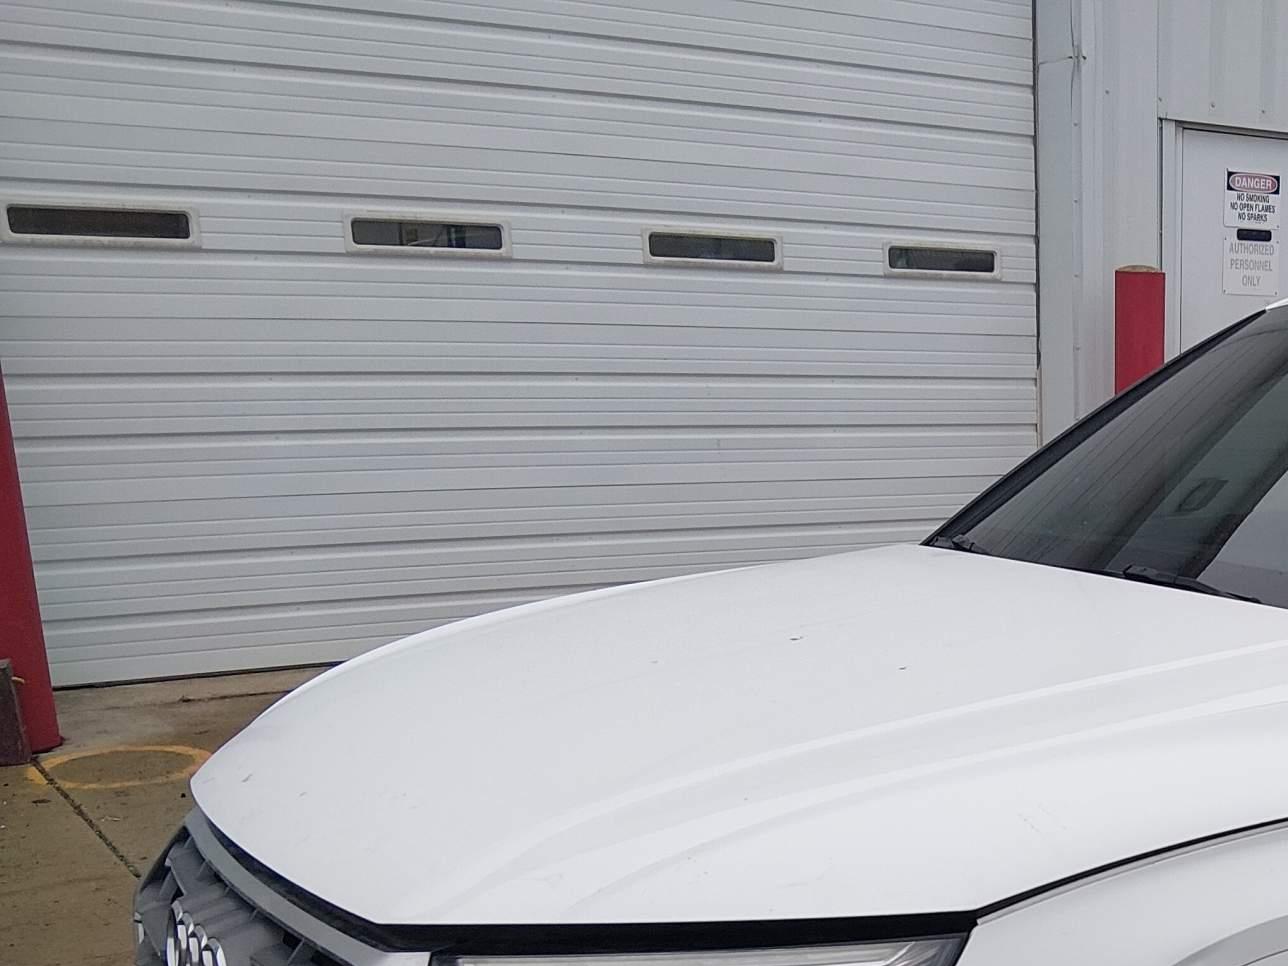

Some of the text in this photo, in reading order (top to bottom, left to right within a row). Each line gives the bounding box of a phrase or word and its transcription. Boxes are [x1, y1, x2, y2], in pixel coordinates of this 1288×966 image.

[1235, 176, 1272, 190] DANGER
[1237, 193, 1270, 203] NO SMOKING
[1230, 202, 1275, 213] NO OPEN FLAMES
[1238, 213, 1268, 222] NO SPARKS
[1230, 242, 1274, 256] AUTHORIZED
[1230, 258, 1273, 271] PERSONNEL
[1242, 275, 1261, 287] ONLY
